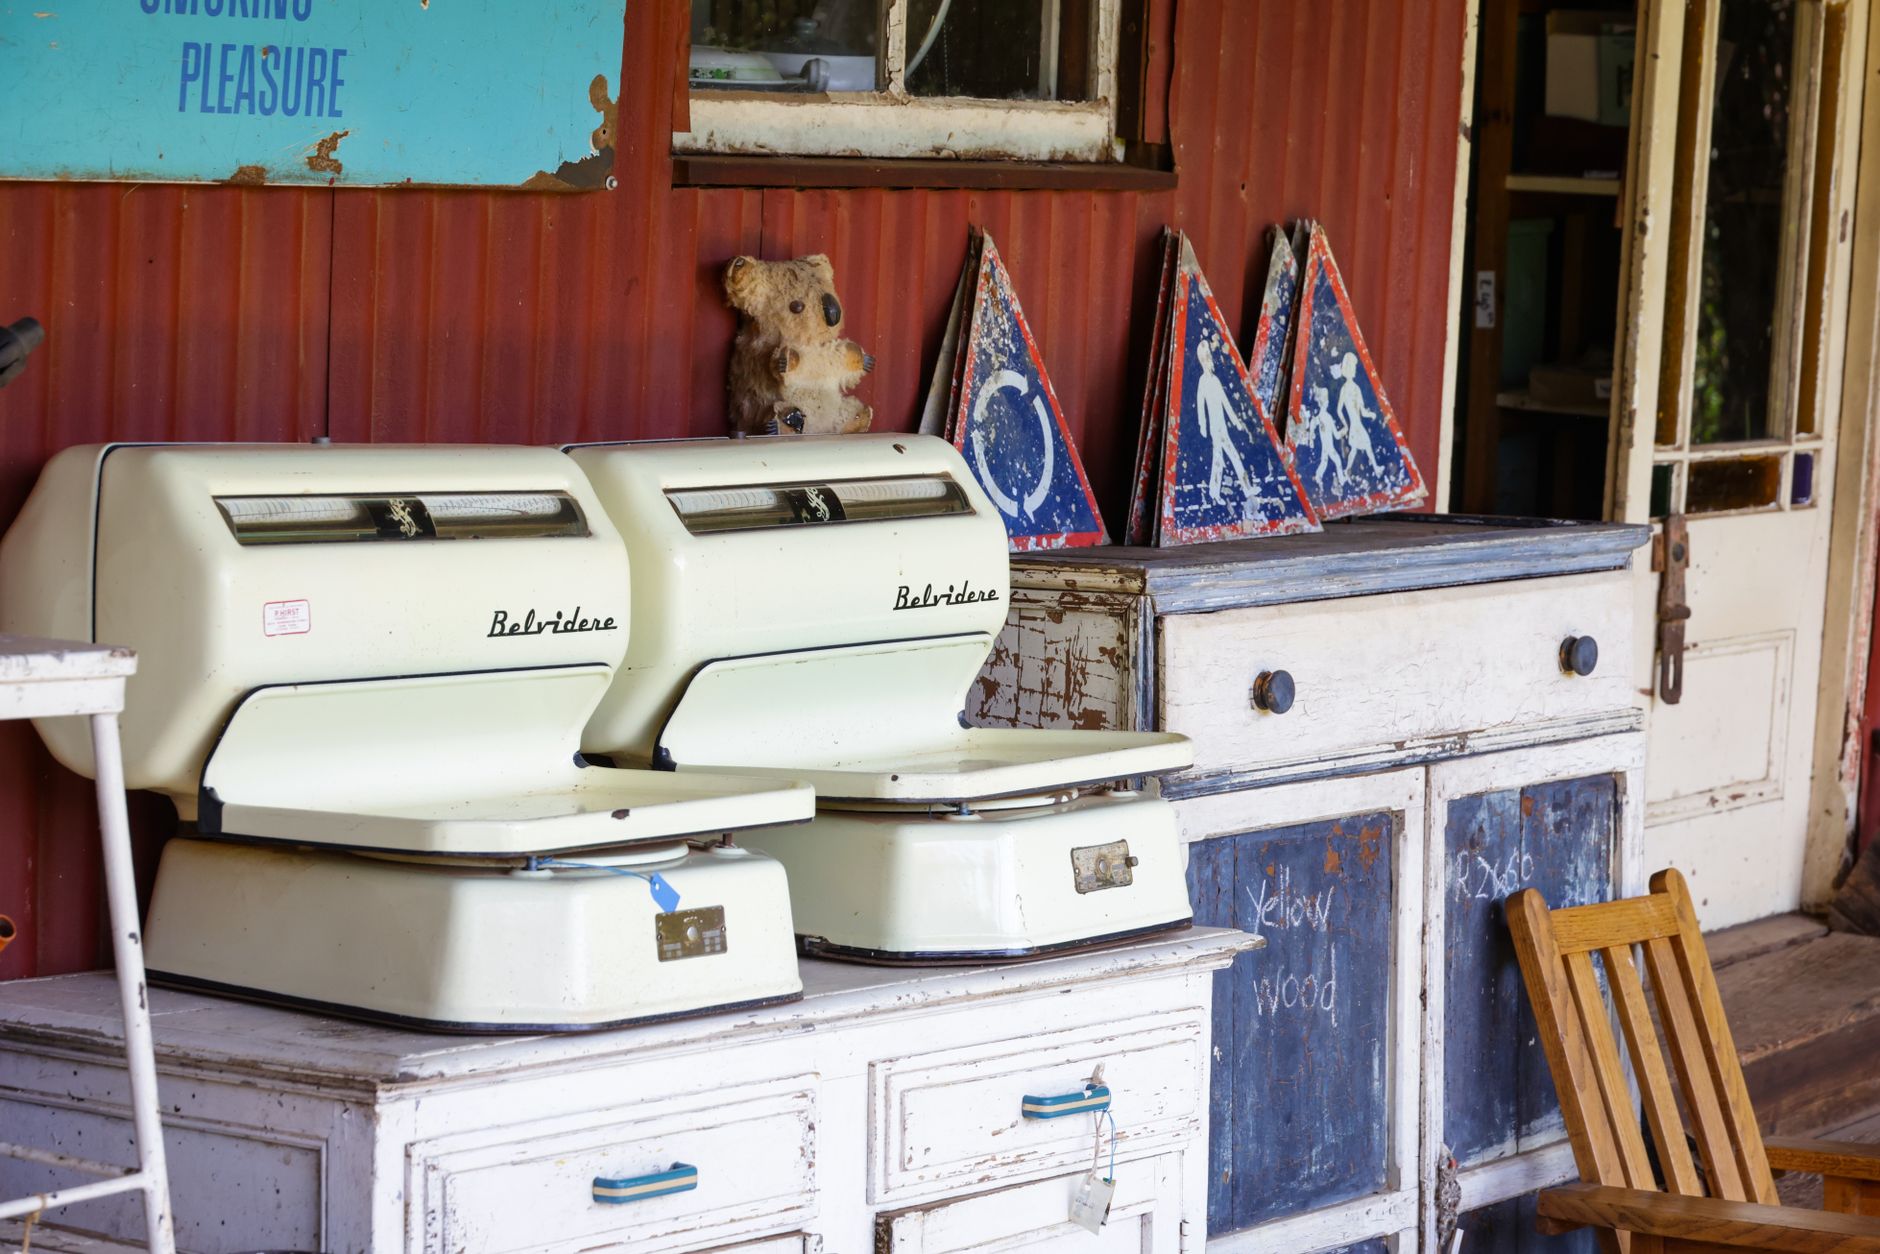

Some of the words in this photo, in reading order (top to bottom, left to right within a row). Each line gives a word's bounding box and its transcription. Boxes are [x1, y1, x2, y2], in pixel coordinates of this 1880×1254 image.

[178, 41, 348, 118] PLEASURE
[892, 579, 1000, 611] Belvidere
[486, 605, 618, 637] Belvidere
